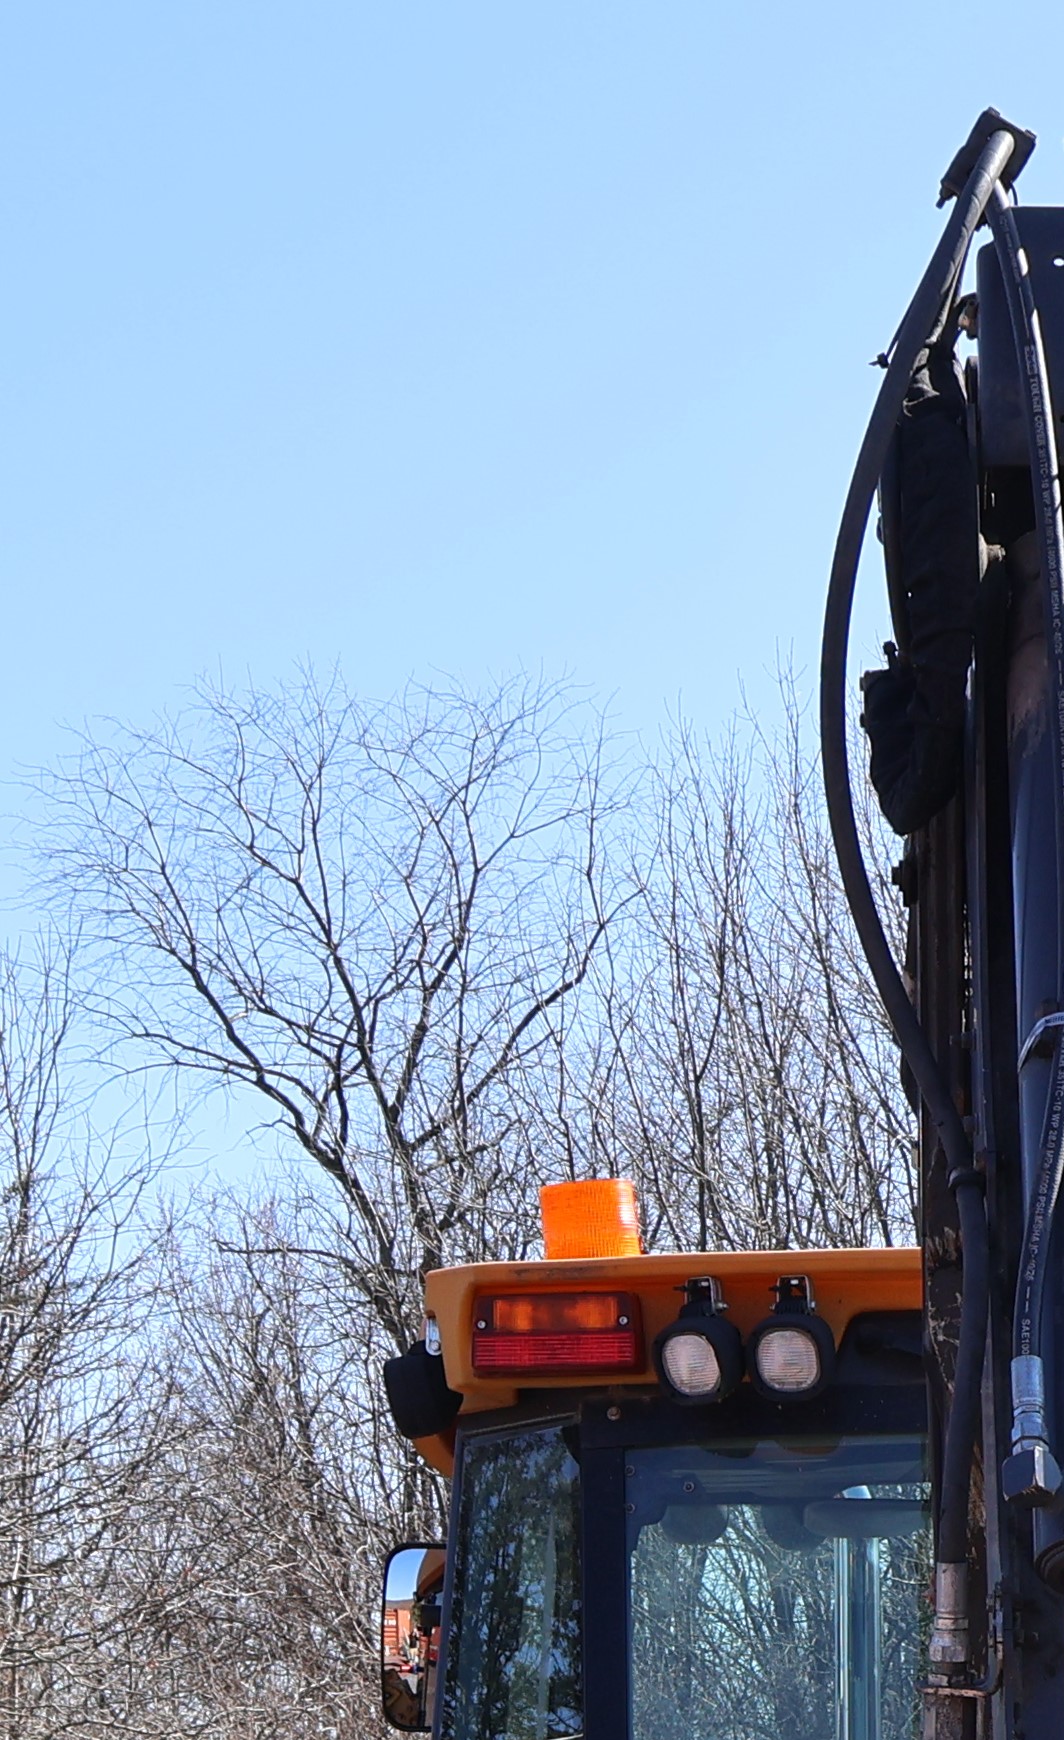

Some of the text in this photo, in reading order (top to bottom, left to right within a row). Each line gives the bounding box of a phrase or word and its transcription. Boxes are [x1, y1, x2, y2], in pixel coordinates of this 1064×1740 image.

[1034, 415, 1046, 447] COVER
[1051, 590, 1060, 617] MSHA
[1050, 1113, 1060, 1128] WP
[1020, 1318, 1031, 1356] SAE100
